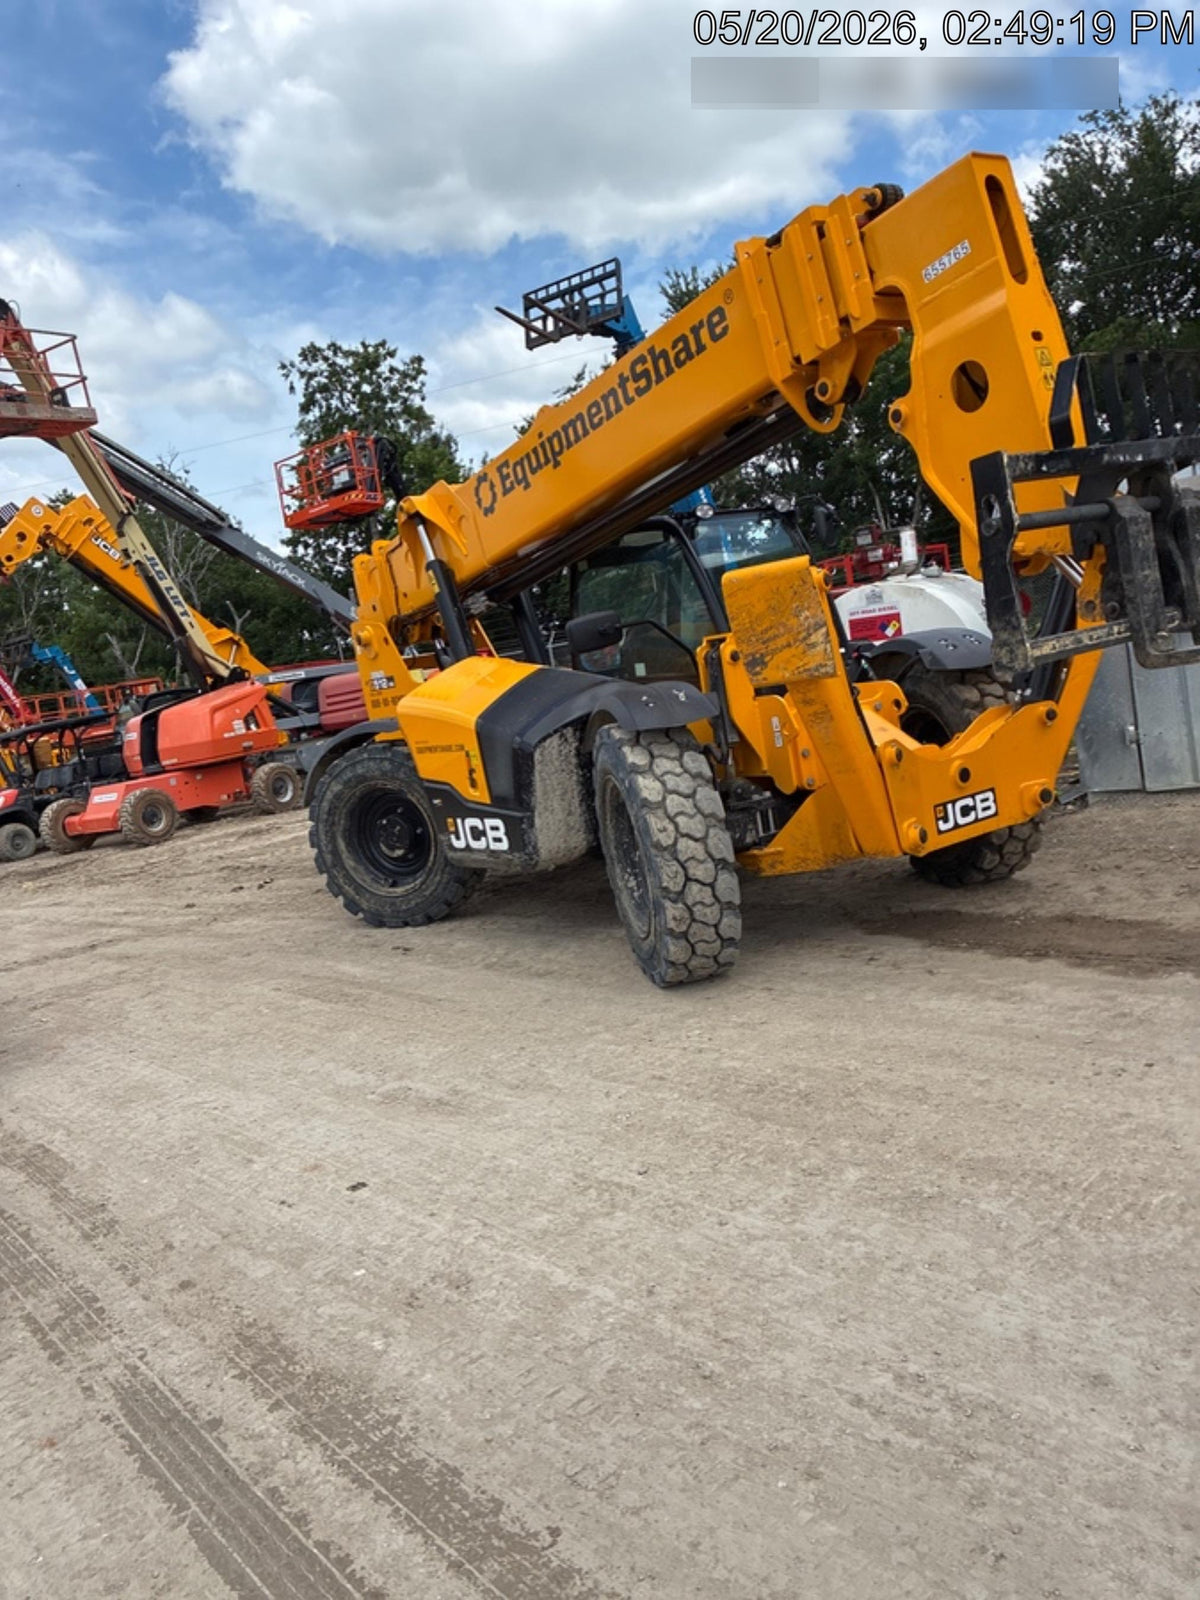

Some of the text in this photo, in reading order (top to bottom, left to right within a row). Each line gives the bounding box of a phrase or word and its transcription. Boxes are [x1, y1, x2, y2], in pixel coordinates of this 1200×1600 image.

[922, 241, 970, 282] 655765
[496, 304, 730, 497] EquipmentShare
[91, 536, 121, 560] JCB
[144, 554, 190, 619] JLG LIFT
[937, 791, 996, 831] JCB
[448, 817, 509, 850] JCB
